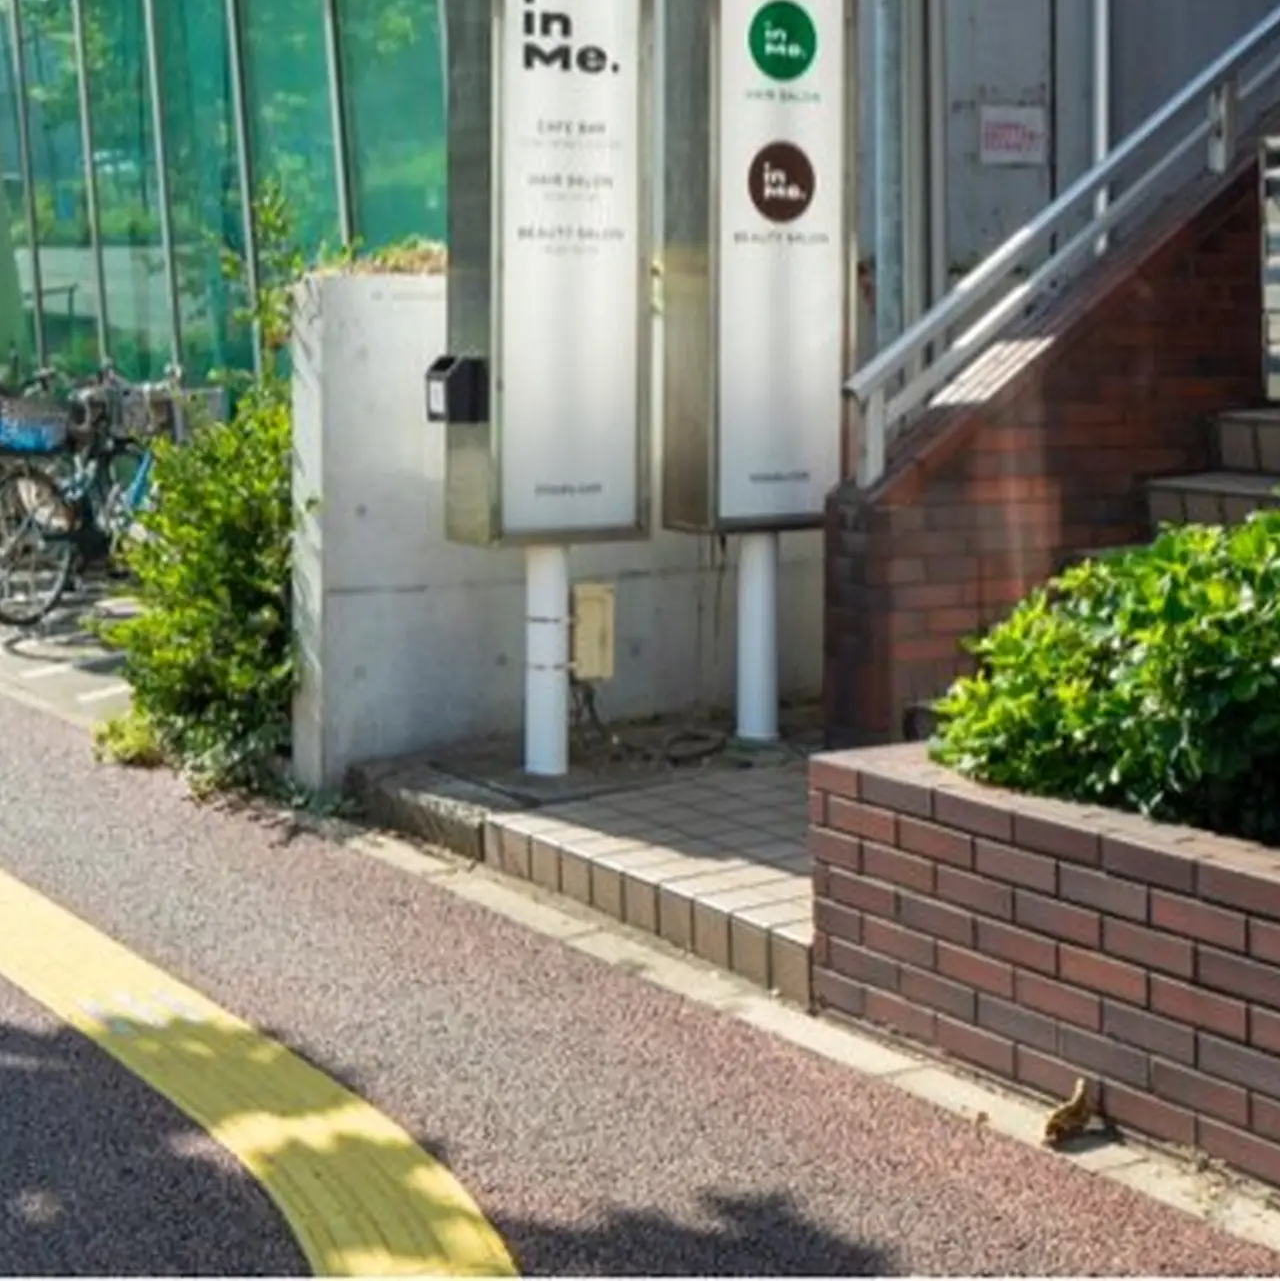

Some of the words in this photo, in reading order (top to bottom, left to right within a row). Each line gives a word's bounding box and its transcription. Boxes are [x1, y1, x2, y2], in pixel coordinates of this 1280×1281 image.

[763, 20, 788, 43] in
[523, 42, 621, 74] Me.
[763, 161, 787, 185] in
